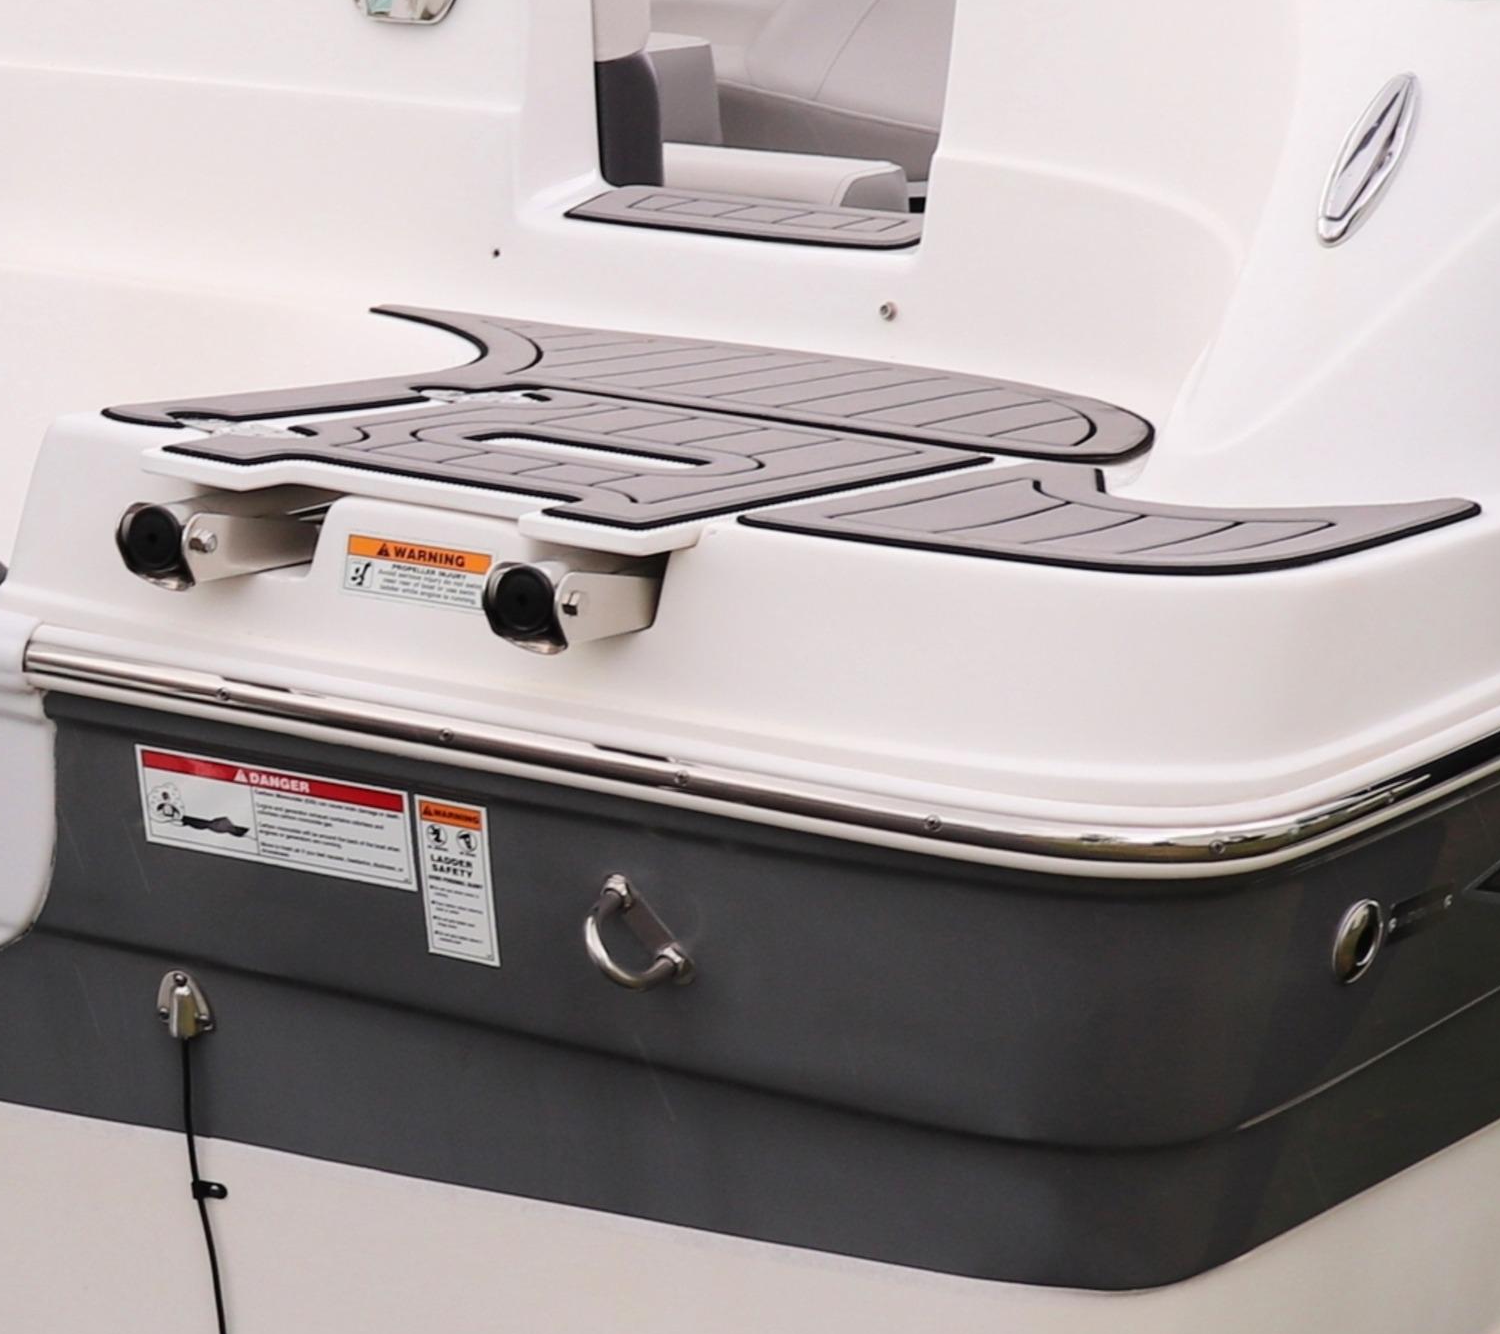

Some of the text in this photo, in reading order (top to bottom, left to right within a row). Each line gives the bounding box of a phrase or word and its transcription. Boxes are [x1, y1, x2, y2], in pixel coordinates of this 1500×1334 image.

[393, 546, 466, 568] WARNING
[248, 771, 310, 794] DANGER
[430, 853, 473, 867] LADDER
[431, 864, 473, 878] SAFETY
